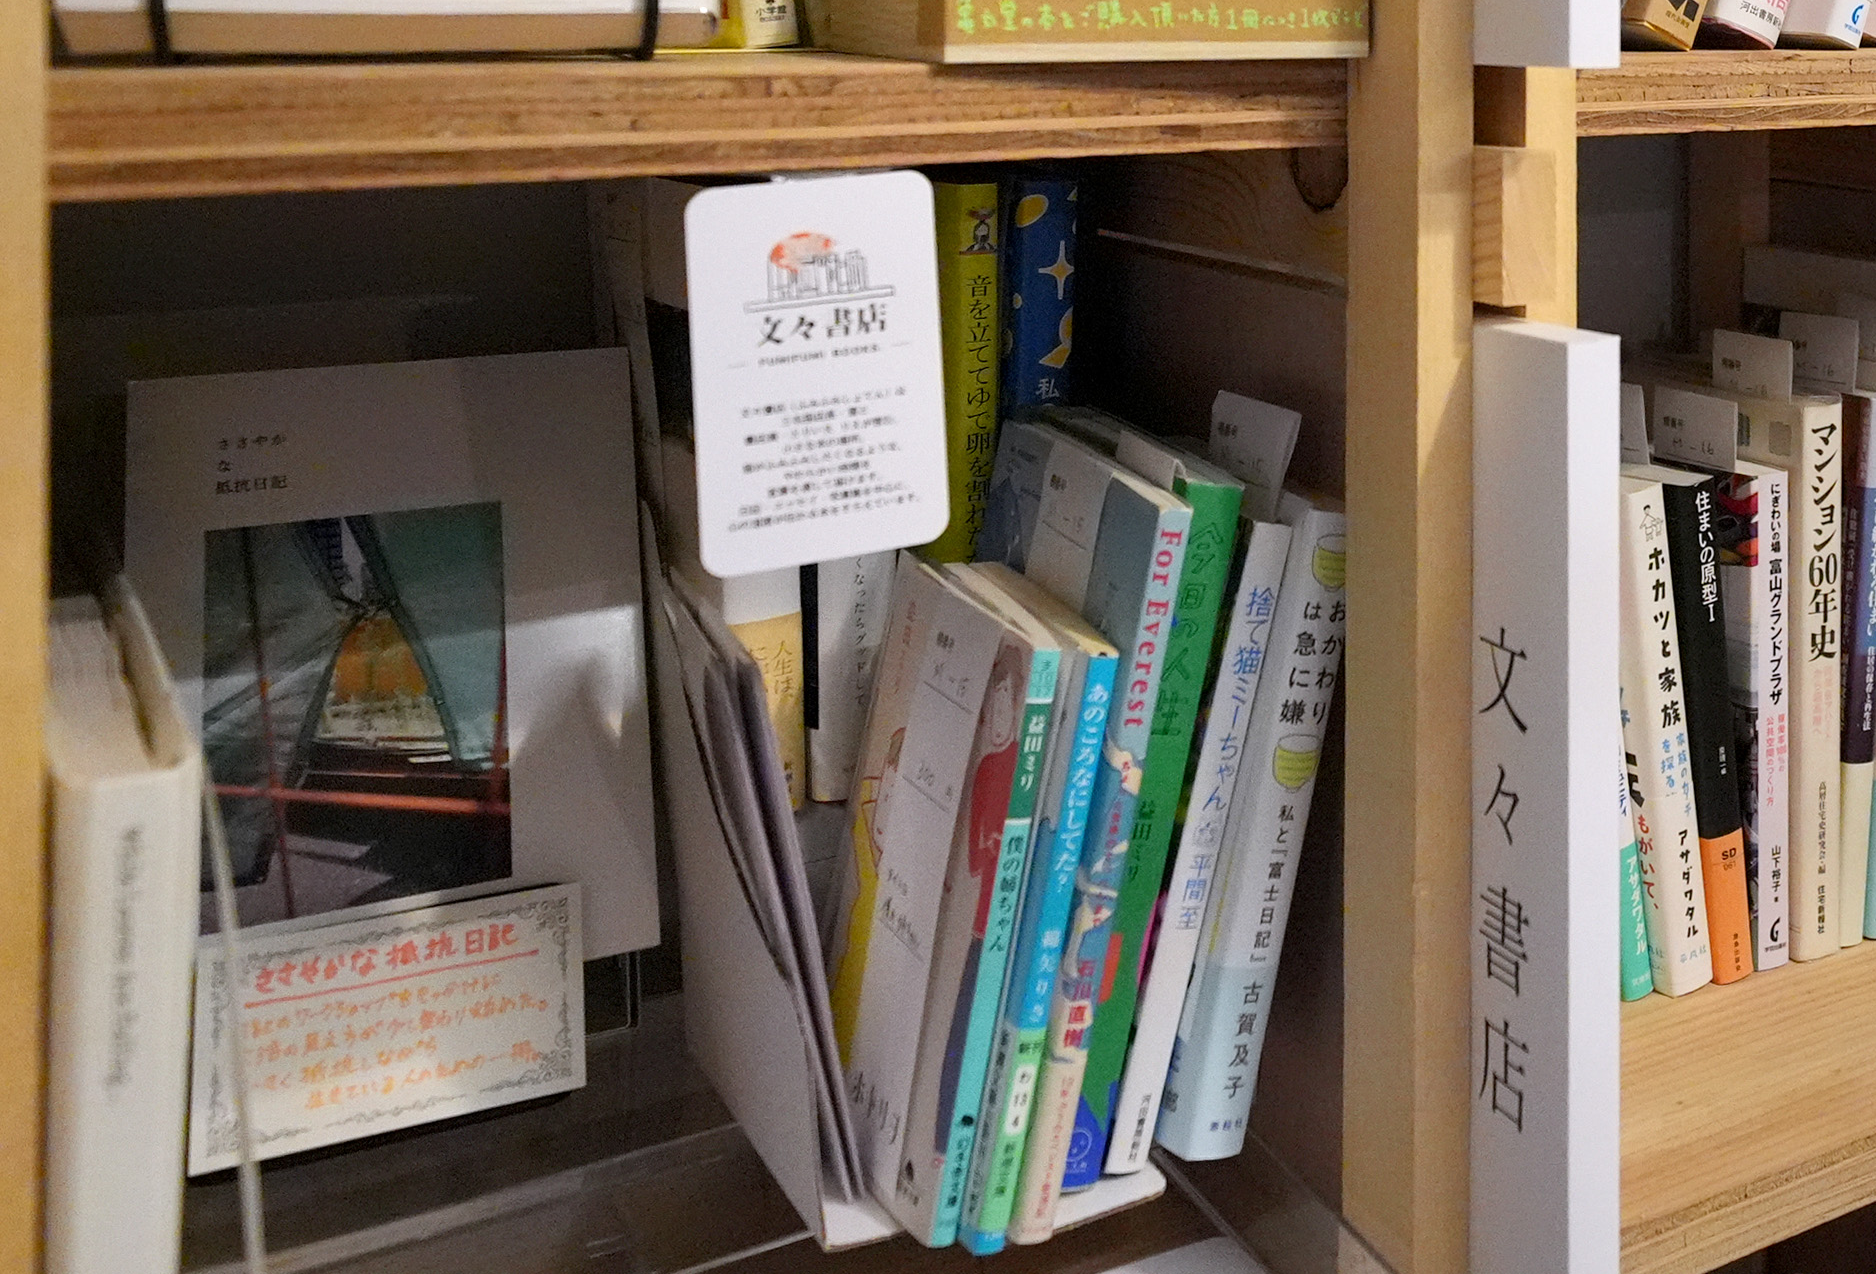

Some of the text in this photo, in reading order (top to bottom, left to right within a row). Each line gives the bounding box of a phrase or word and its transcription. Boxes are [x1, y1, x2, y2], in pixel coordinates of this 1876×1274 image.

[758, 303, 887, 347] 文々書店
[965, 274, 992, 564] 音を立ててゆで卵を割れ
[1769, 483, 1785, 705] にぎわいの場 富山グランドプラザ
[1808, 422, 1838, 662] マンション60年史
[1124, 528, 1183, 728] For Everest
[1279, 601, 1322, 724] は急に嫌
[1648, 548, 1682, 729] ホカツと家族
[1479, 627, 1529, 1134] 文々書店
[1627, 856, 1647, 956] アサダワタル
[1678, 829, 1698, 939] アサダワタル
[1721, 847, 1737, 861] SD
[1771, 846, 1782, 892] 山下裕子
[1224, 981, 1263, 1099] 古賀及子
